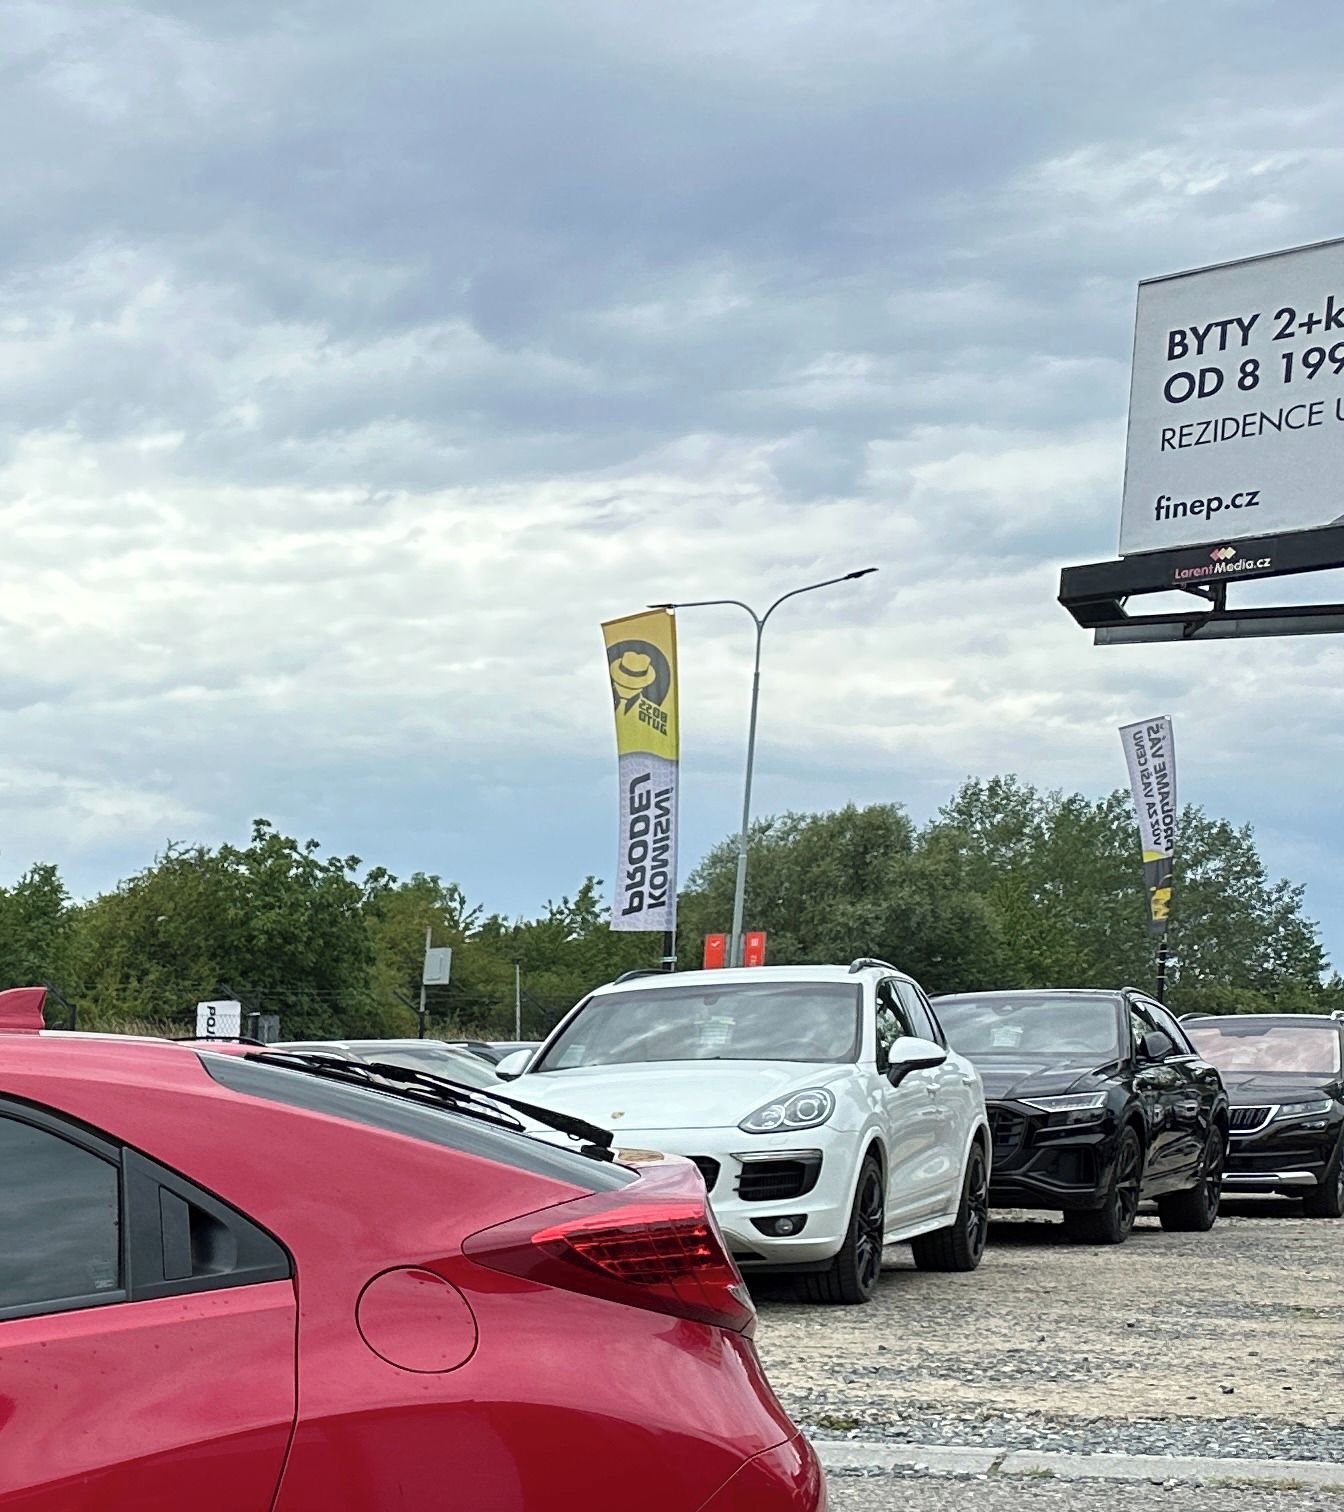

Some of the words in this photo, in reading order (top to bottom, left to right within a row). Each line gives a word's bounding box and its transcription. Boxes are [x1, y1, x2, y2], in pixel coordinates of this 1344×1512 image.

[1168, 313, 1261, 361] BYTY
[1164, 367, 1224, 403] OD
[1238, 359, 1260, 391] 8
[1282, 341, 1344, 384] 199
[1161, 401, 1324, 451] REZIDENCE
[1155, 490, 1261, 520] finep.cz
[1174, 557, 1271, 579] LarentMedia.cz
